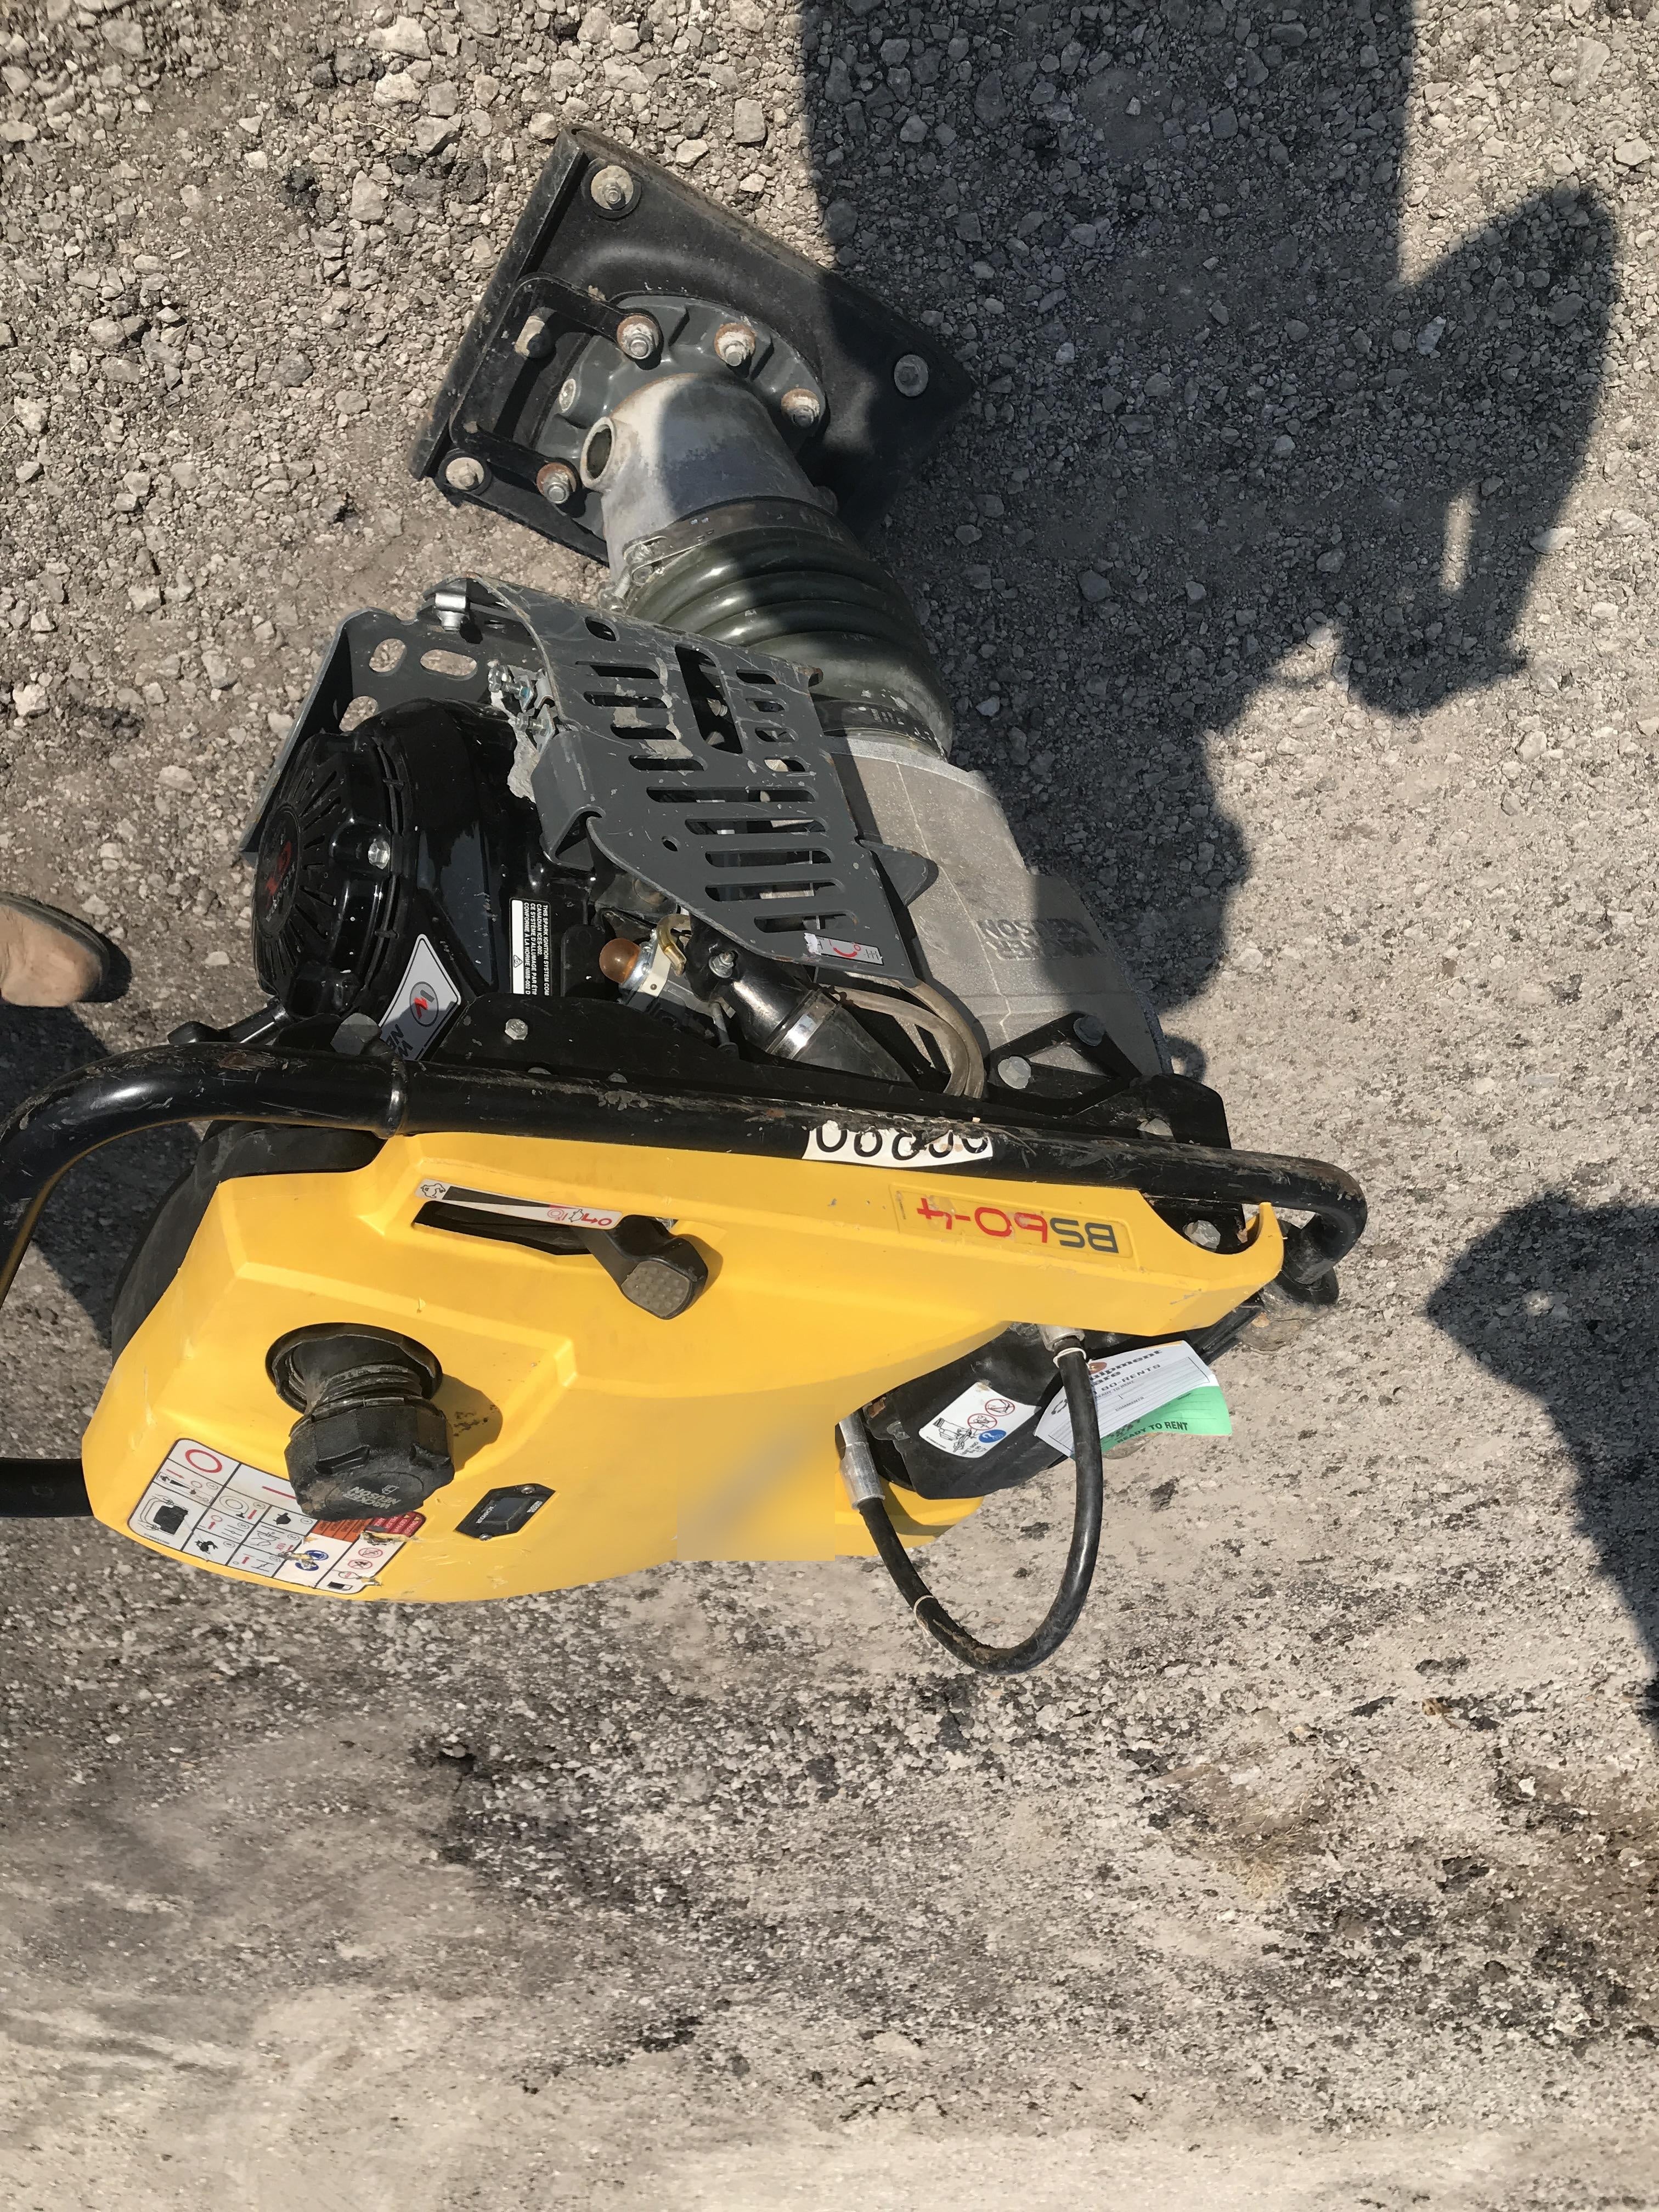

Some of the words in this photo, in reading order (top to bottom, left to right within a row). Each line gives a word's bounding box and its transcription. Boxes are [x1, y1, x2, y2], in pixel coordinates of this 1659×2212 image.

[530, 902, 536, 911] CE
[916, 1198, 1119, 1254] BS60-4
[1090, 1350, 1163, 1381] uipment
[1164, 1421, 1188, 1431] RENT
[342, 1491, 391, 1509] WACKER
[352, 1486, 403, 1506] NEUSON
